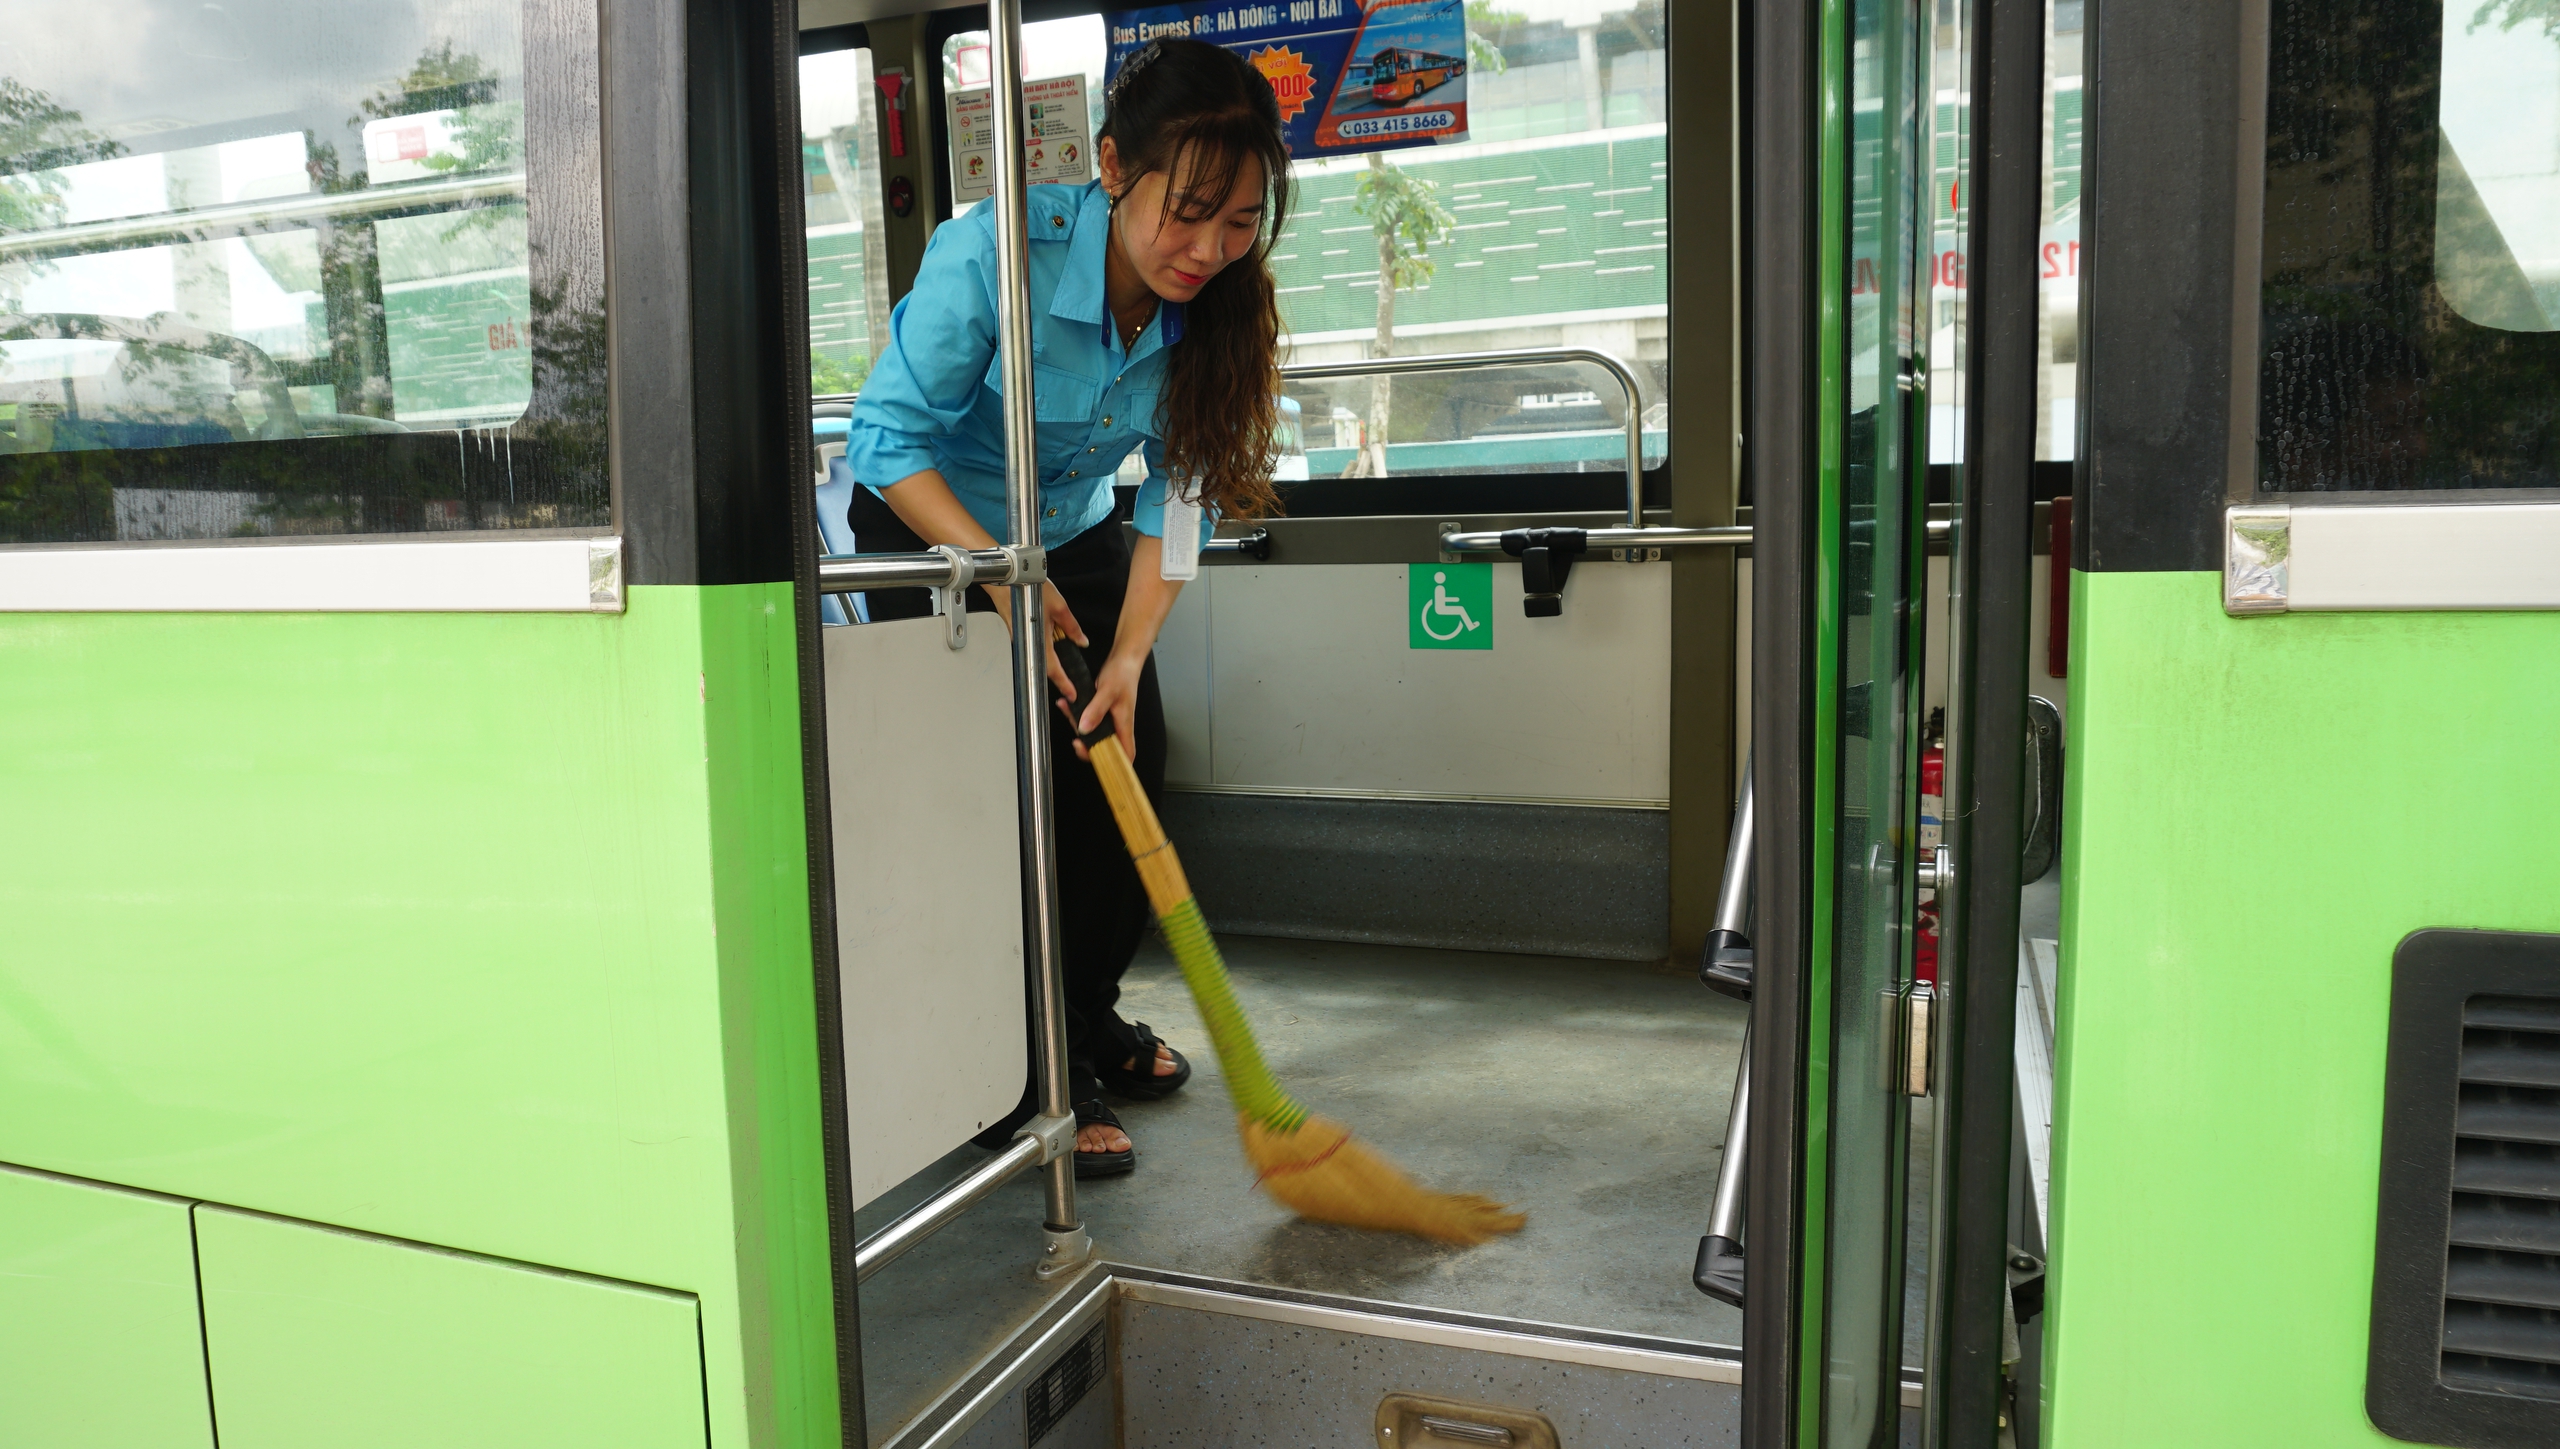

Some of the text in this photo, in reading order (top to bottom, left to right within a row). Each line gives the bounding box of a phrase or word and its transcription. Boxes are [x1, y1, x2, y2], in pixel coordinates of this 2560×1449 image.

[1113, 26, 1136, 45] Bus
[1139, 20, 1191, 42] Express
[1193, 14, 1214, 34] 68:
[1217, 7, 1236, 32] HÀ
[1239, 4, 1277, 29] ĐÔNG
[1354, 114, 1448, 135] 033 415 8668
